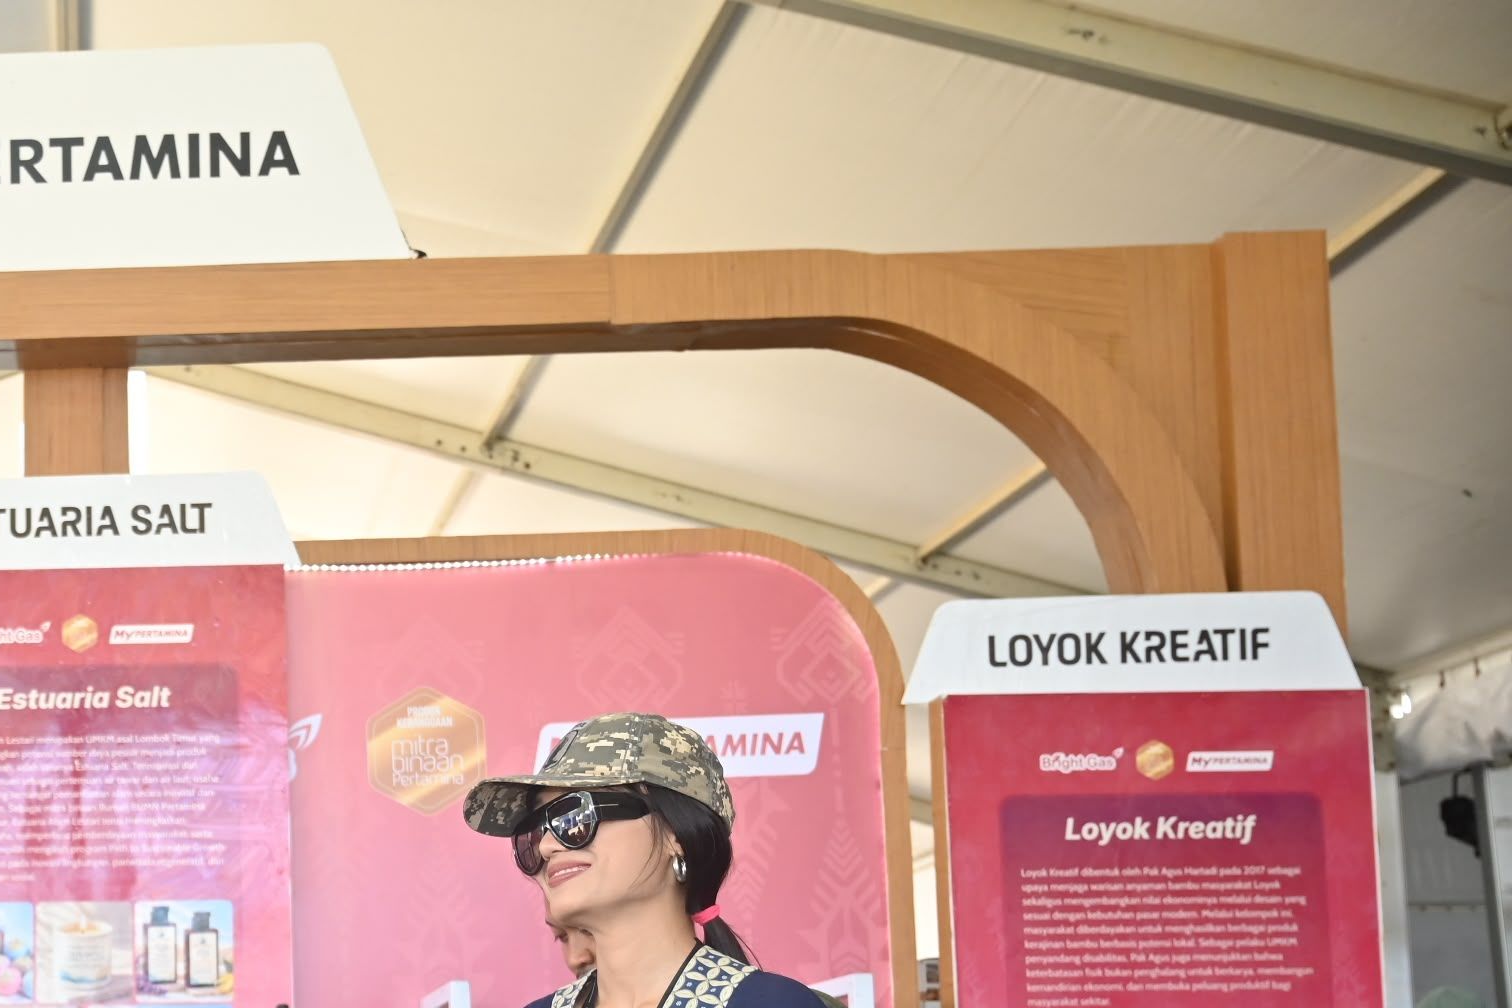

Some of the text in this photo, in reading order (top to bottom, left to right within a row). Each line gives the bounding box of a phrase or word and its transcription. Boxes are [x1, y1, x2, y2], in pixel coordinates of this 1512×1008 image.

[130, 501, 213, 536] SALT
[16, 630, 41, 643] Gas
[988, 627, 1270, 668] LOYOK KREATIF
[114, 684, 172, 709] Salt
[391, 735, 449, 756] mitra
[704, 731, 806, 758] AMINA
[1042, 755, 1114, 773] Bright Gas
[1064, 814, 1257, 847] Loyok Kreatif
